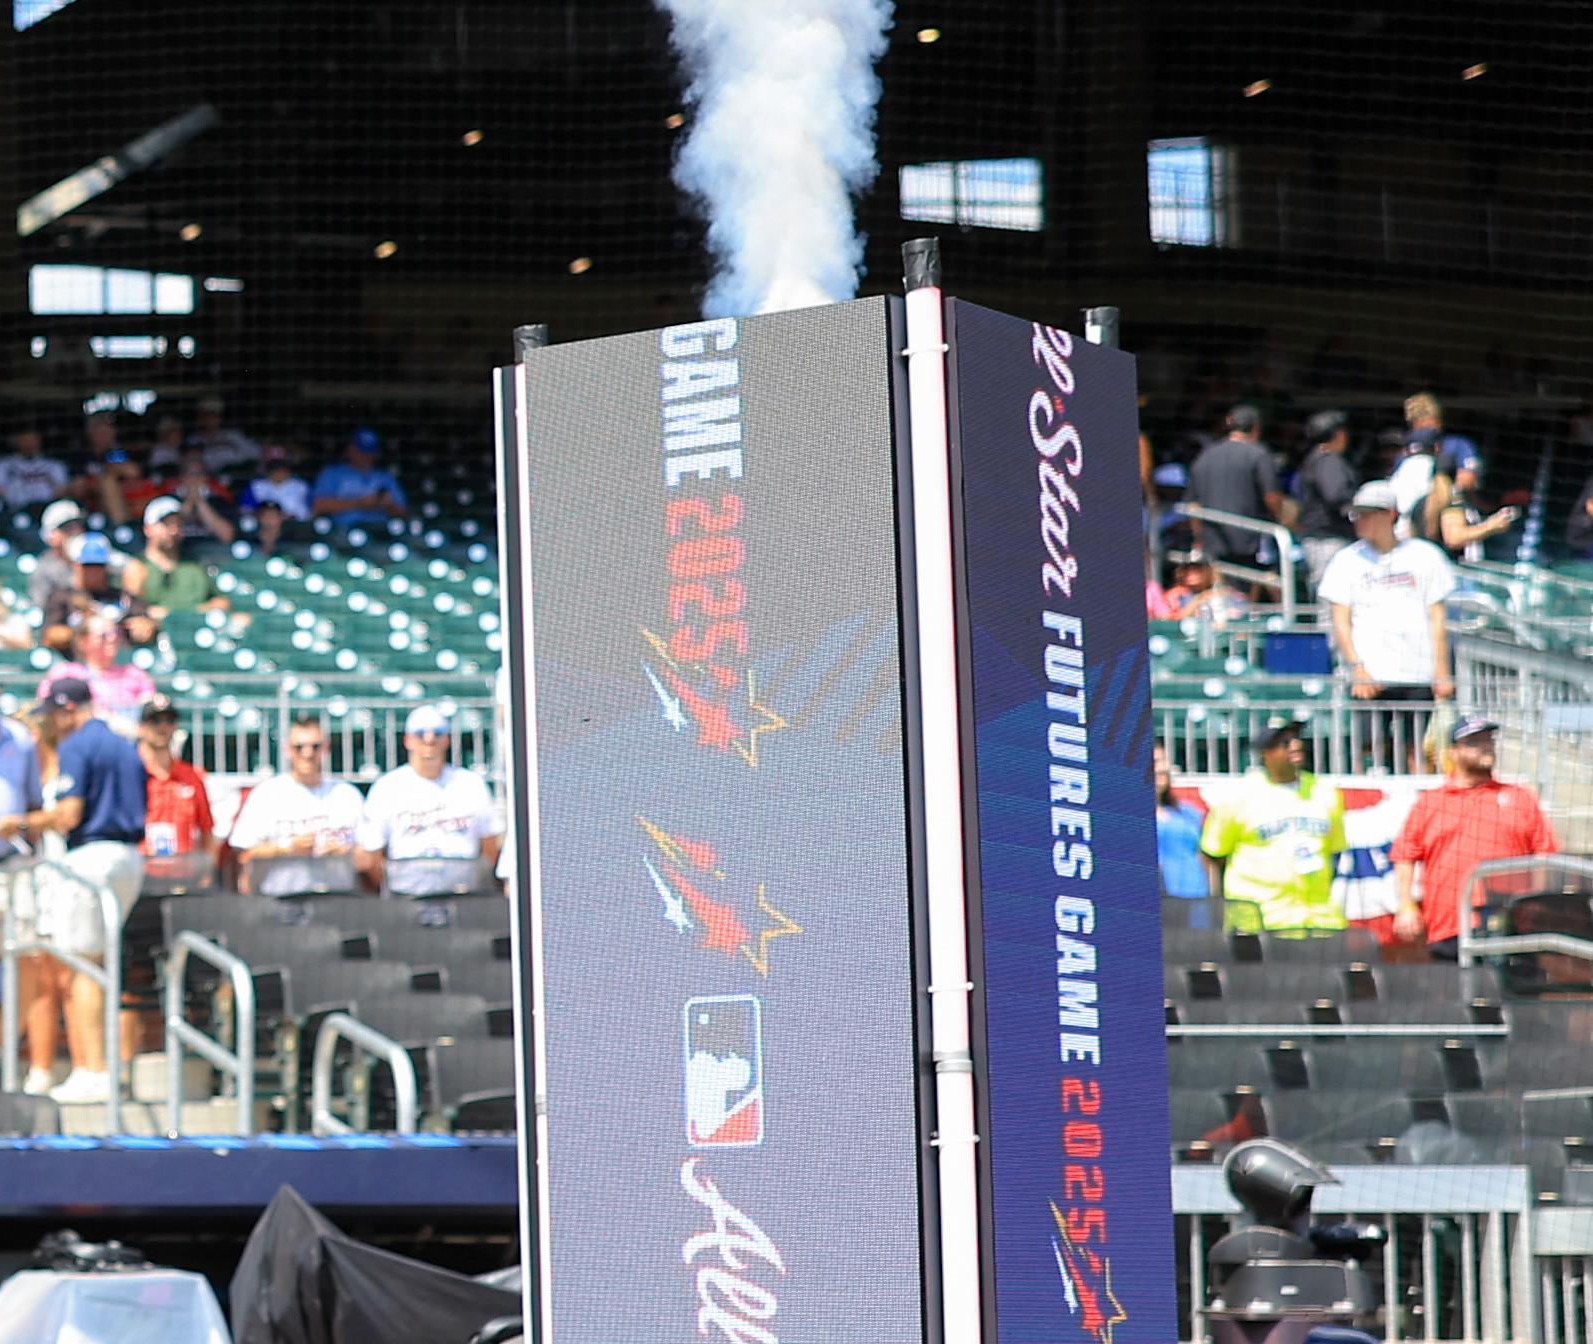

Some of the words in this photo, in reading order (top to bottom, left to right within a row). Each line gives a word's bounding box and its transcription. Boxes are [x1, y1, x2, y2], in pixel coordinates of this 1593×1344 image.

[660, 317, 744, 487] GAME
[665, 495, 751, 662] 2025
[1041, 609, 1093, 881] FUTURES
[1054, 894, 1102, 1066] GAME
[1060, 1076, 1107, 1246] 2025
